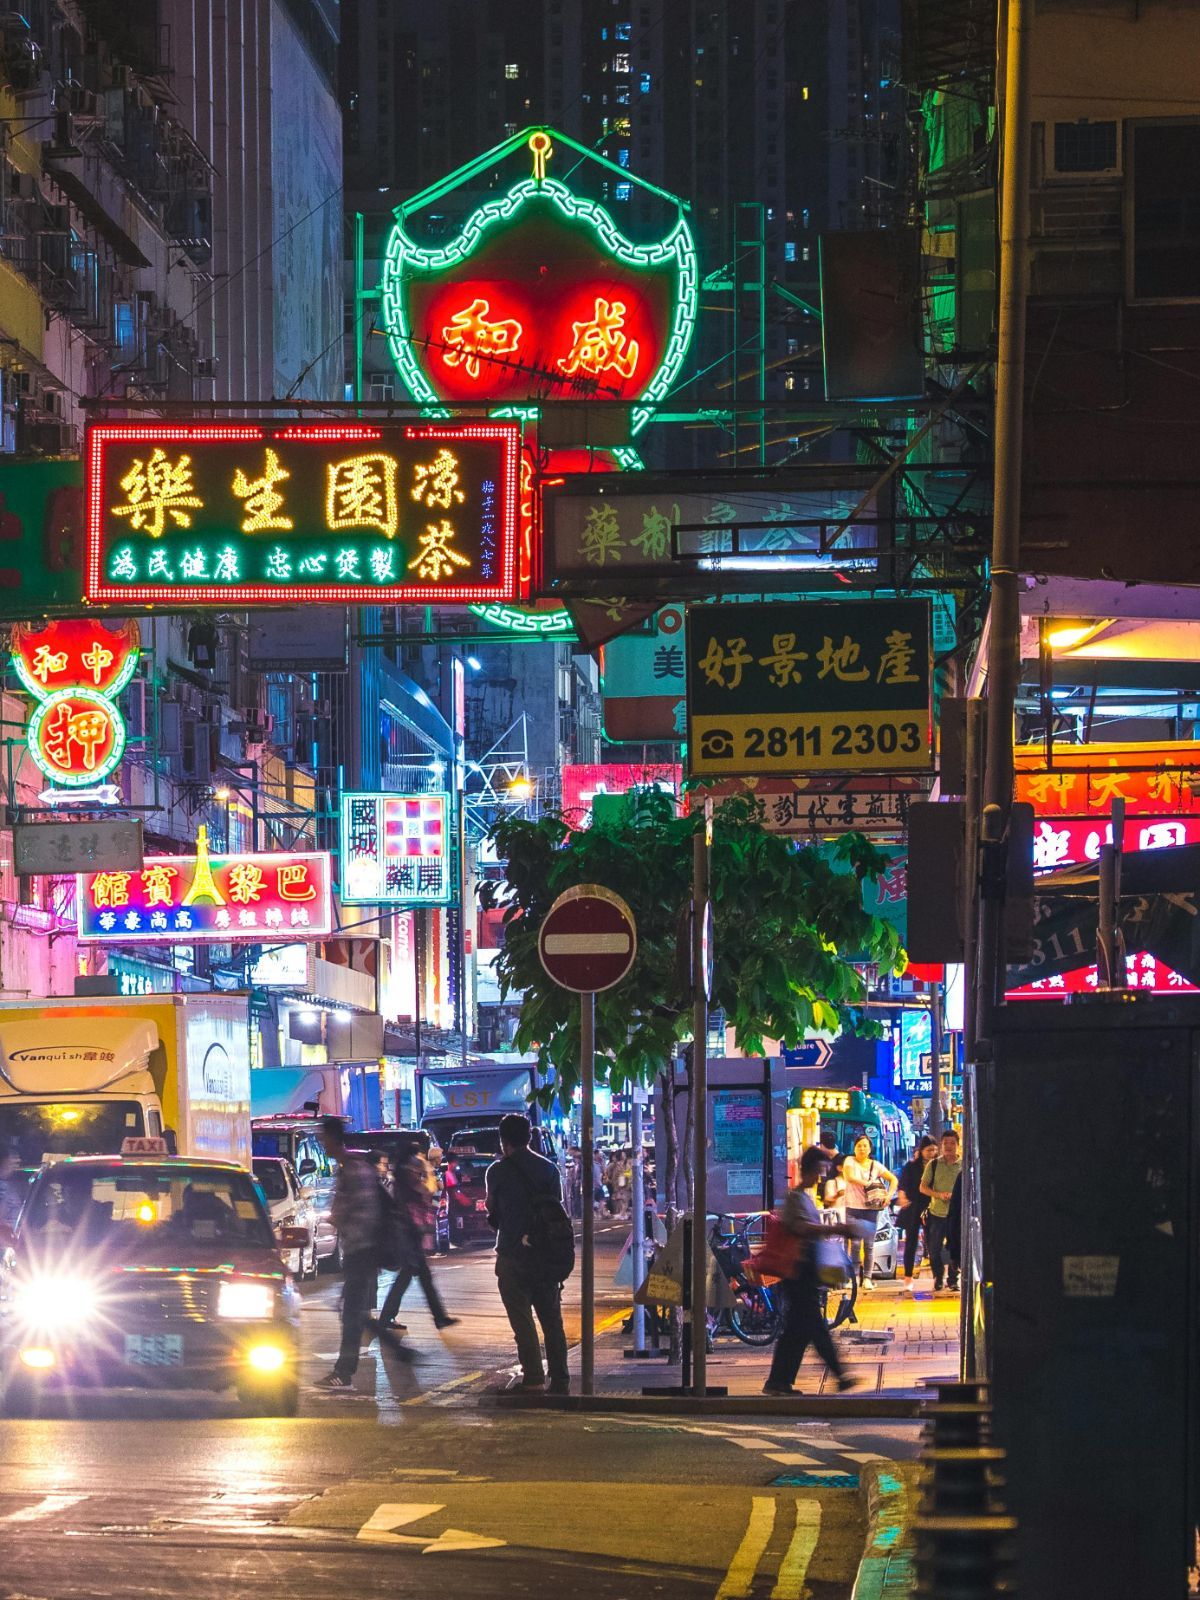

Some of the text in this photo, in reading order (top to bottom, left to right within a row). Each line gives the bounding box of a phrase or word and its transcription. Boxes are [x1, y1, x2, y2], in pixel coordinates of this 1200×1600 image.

[111, 447, 399, 539] 樂生園
[110, 545, 397, 582] 為民健康 忠心煲製
[698, 629, 921, 691] 好景地產
[44, 703, 108, 770] 押
[744, 722, 921, 758] 2811 2303
[20, 1051, 82, 1062] Vanquish
[786, 1042, 816, 1052] quare
[450, 1090, 491, 1108] LST
[126, 1140, 166, 1152] TAXI
